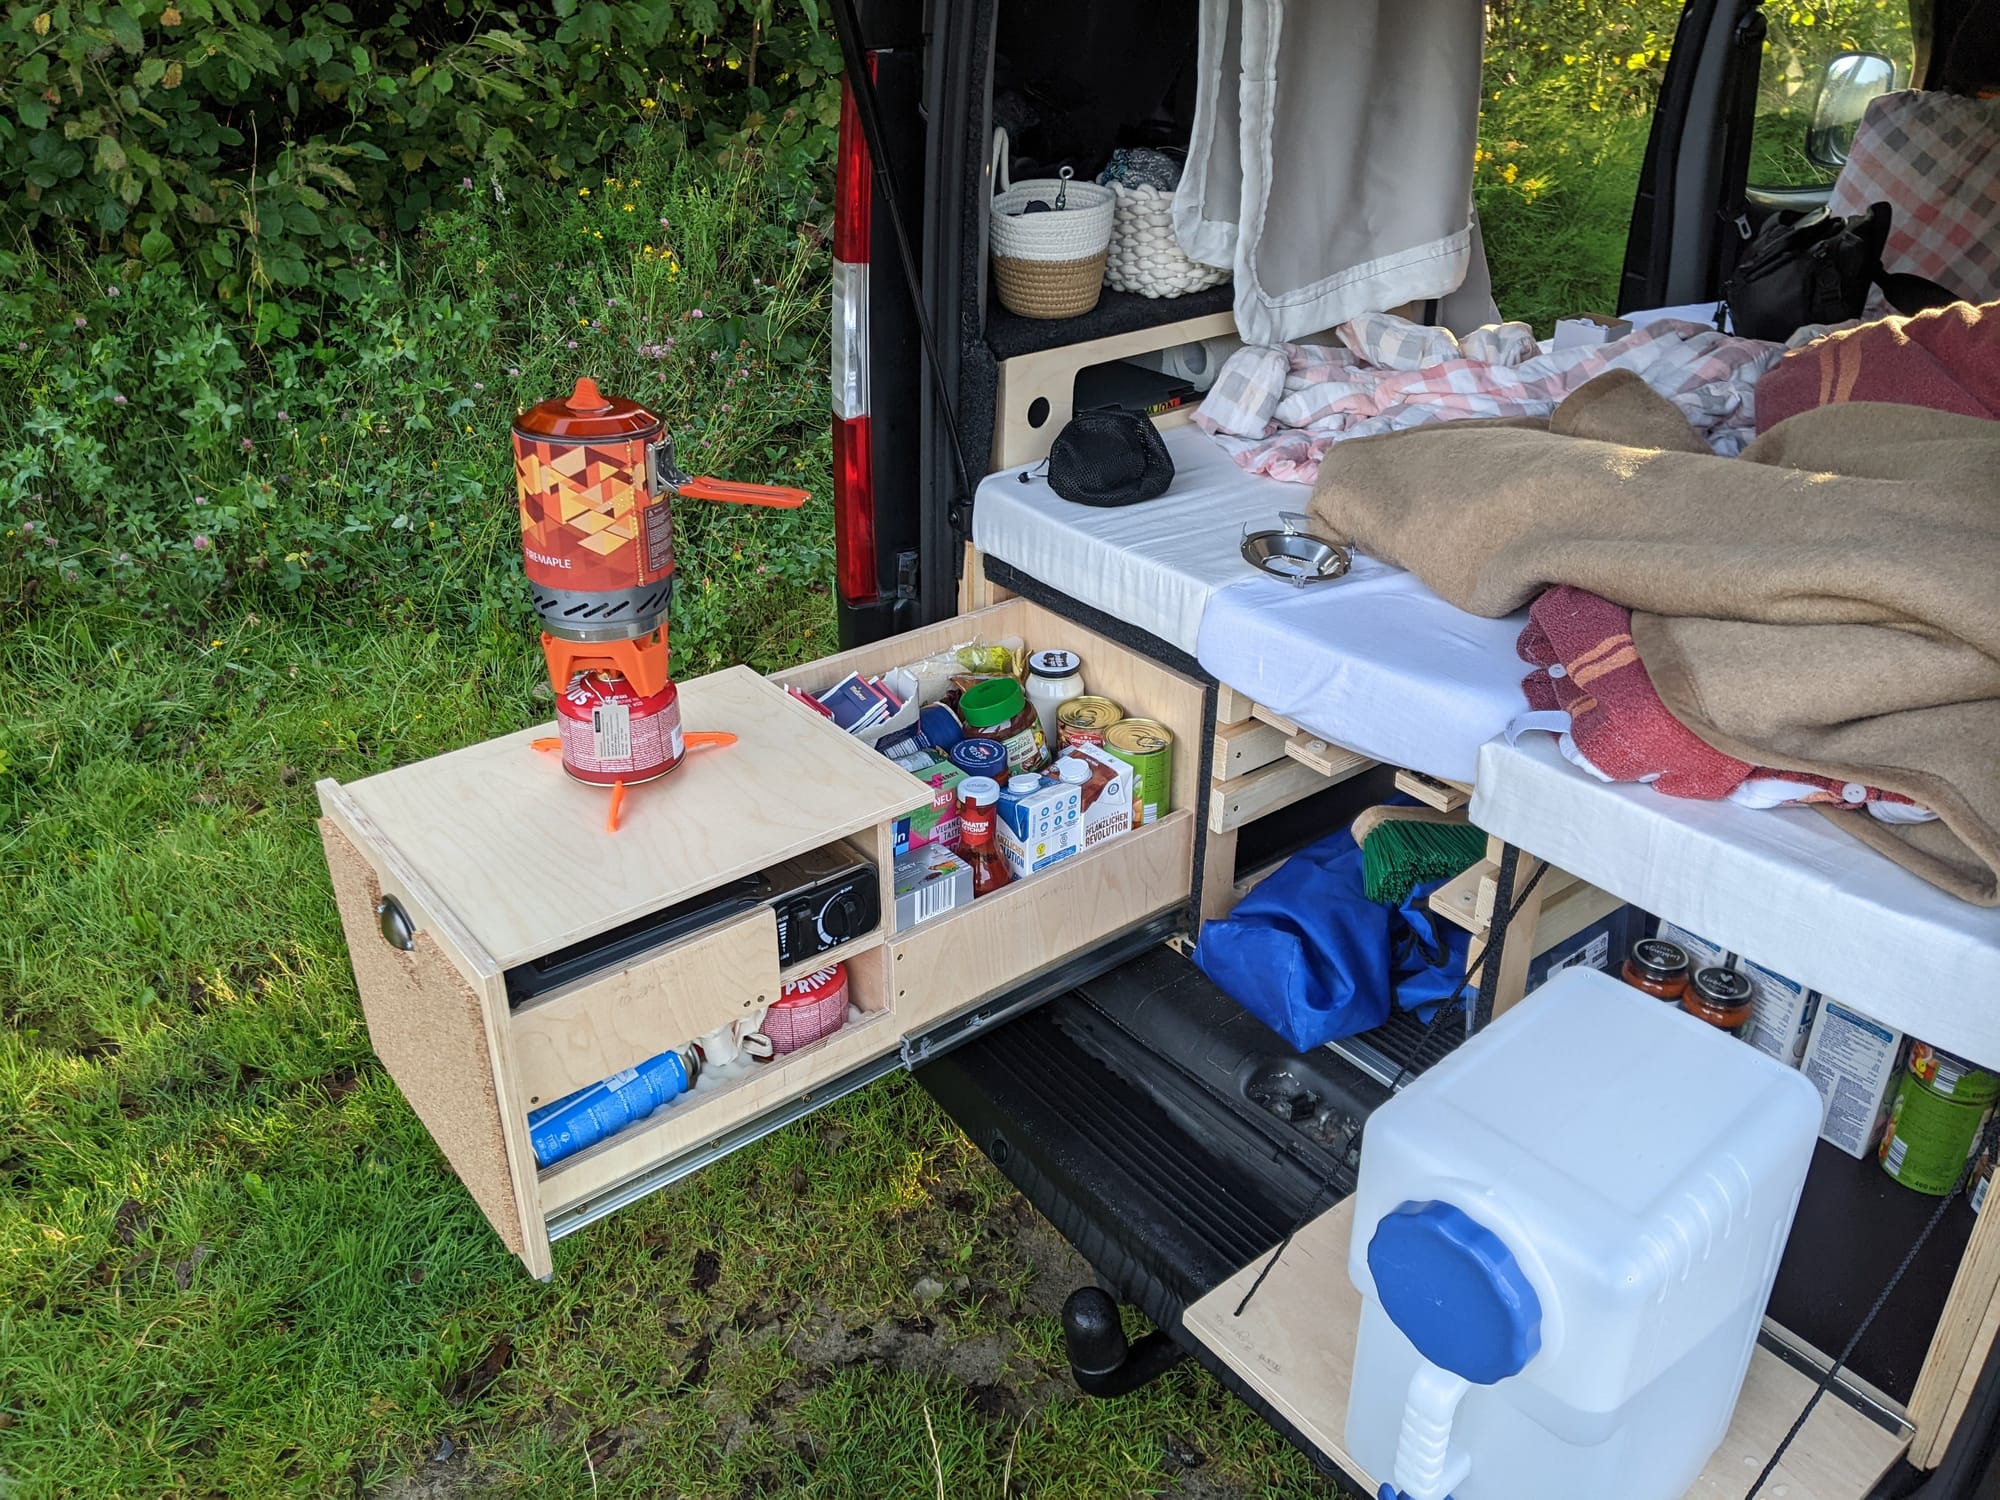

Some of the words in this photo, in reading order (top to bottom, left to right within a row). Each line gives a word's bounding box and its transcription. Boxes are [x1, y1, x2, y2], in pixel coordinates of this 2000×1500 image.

[933, 791, 953, 808] NEU
[961, 819, 989, 830] OMATEN
[1085, 811, 1128, 838] PFLANZLICHEN
[1085, 821, 1128, 848] REVOLUTION
[1000, 844, 1025, 869] OLUTION
[785, 963, 838, 996] PRIMU
